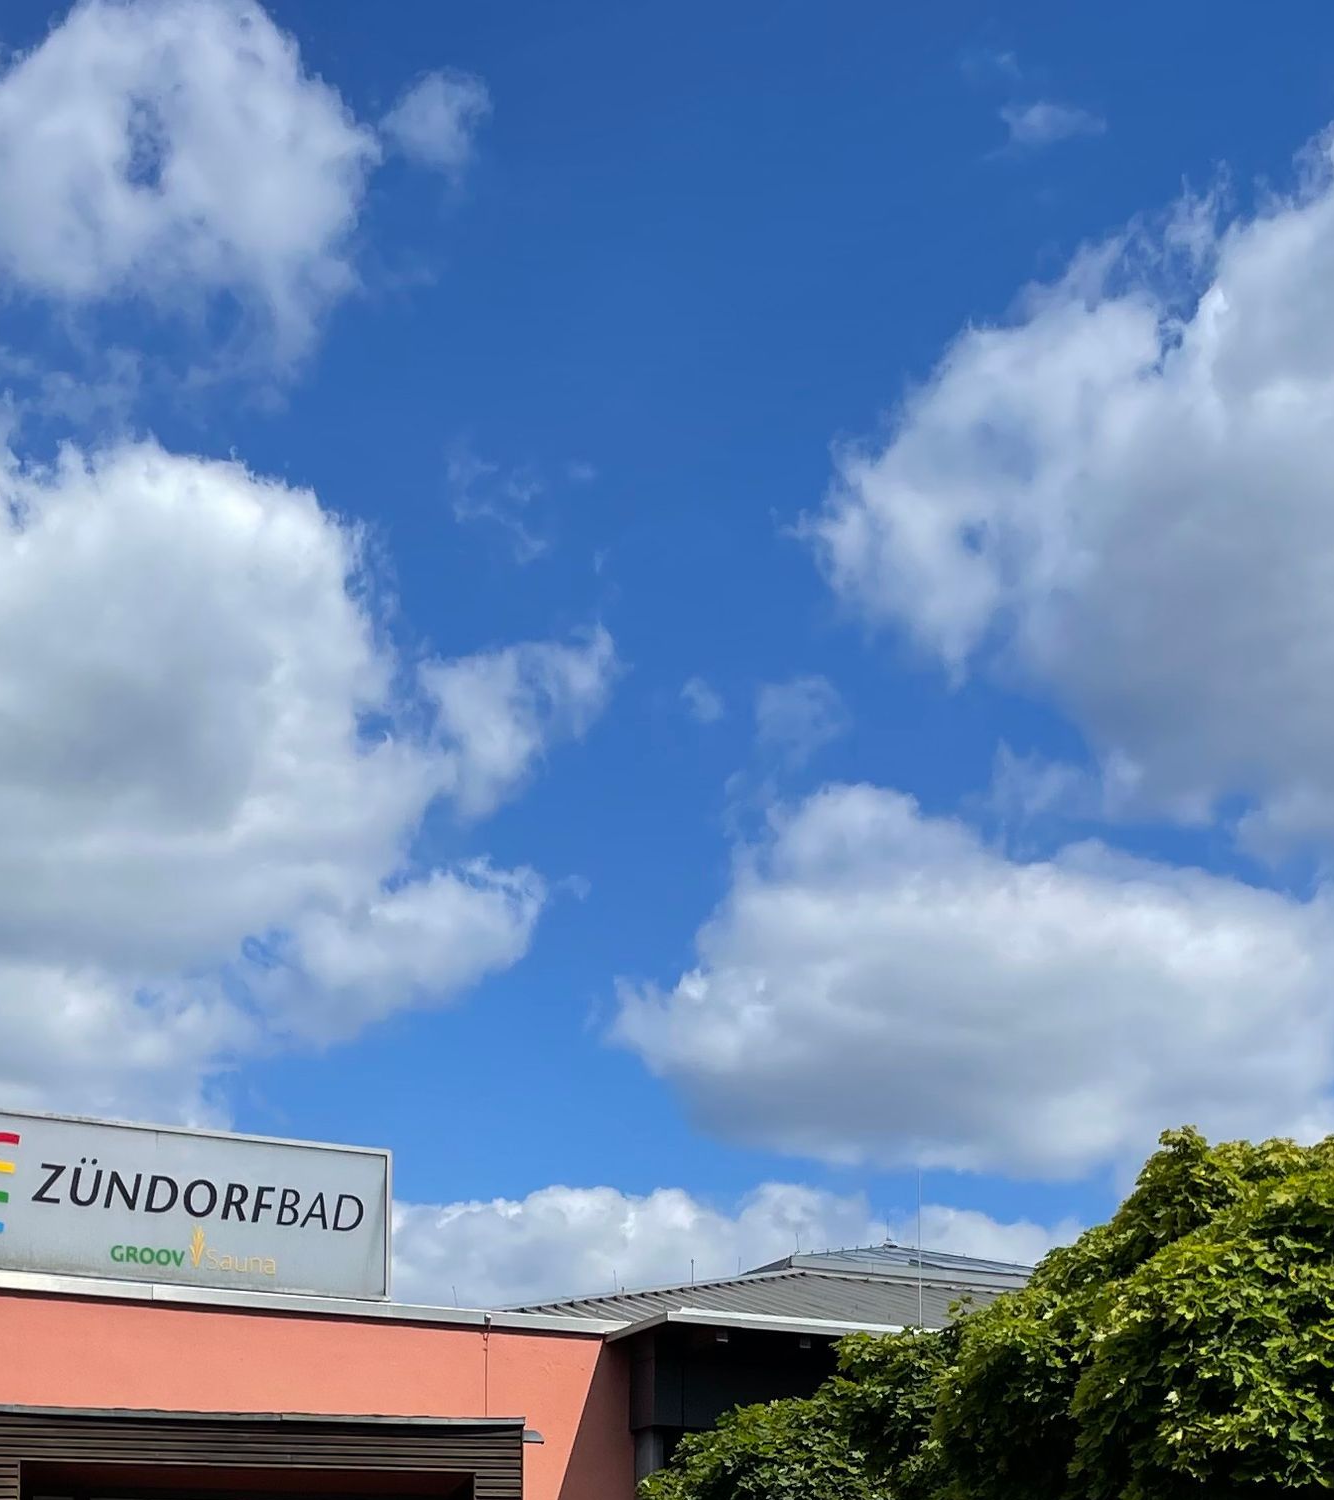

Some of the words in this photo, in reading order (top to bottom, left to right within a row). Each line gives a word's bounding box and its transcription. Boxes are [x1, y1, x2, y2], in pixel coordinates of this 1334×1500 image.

[31, 1157, 365, 1232] ZÜNDORFBAD
[110, 1243, 186, 1268] GROOV
[205, 1248, 277, 1276] Sauna
